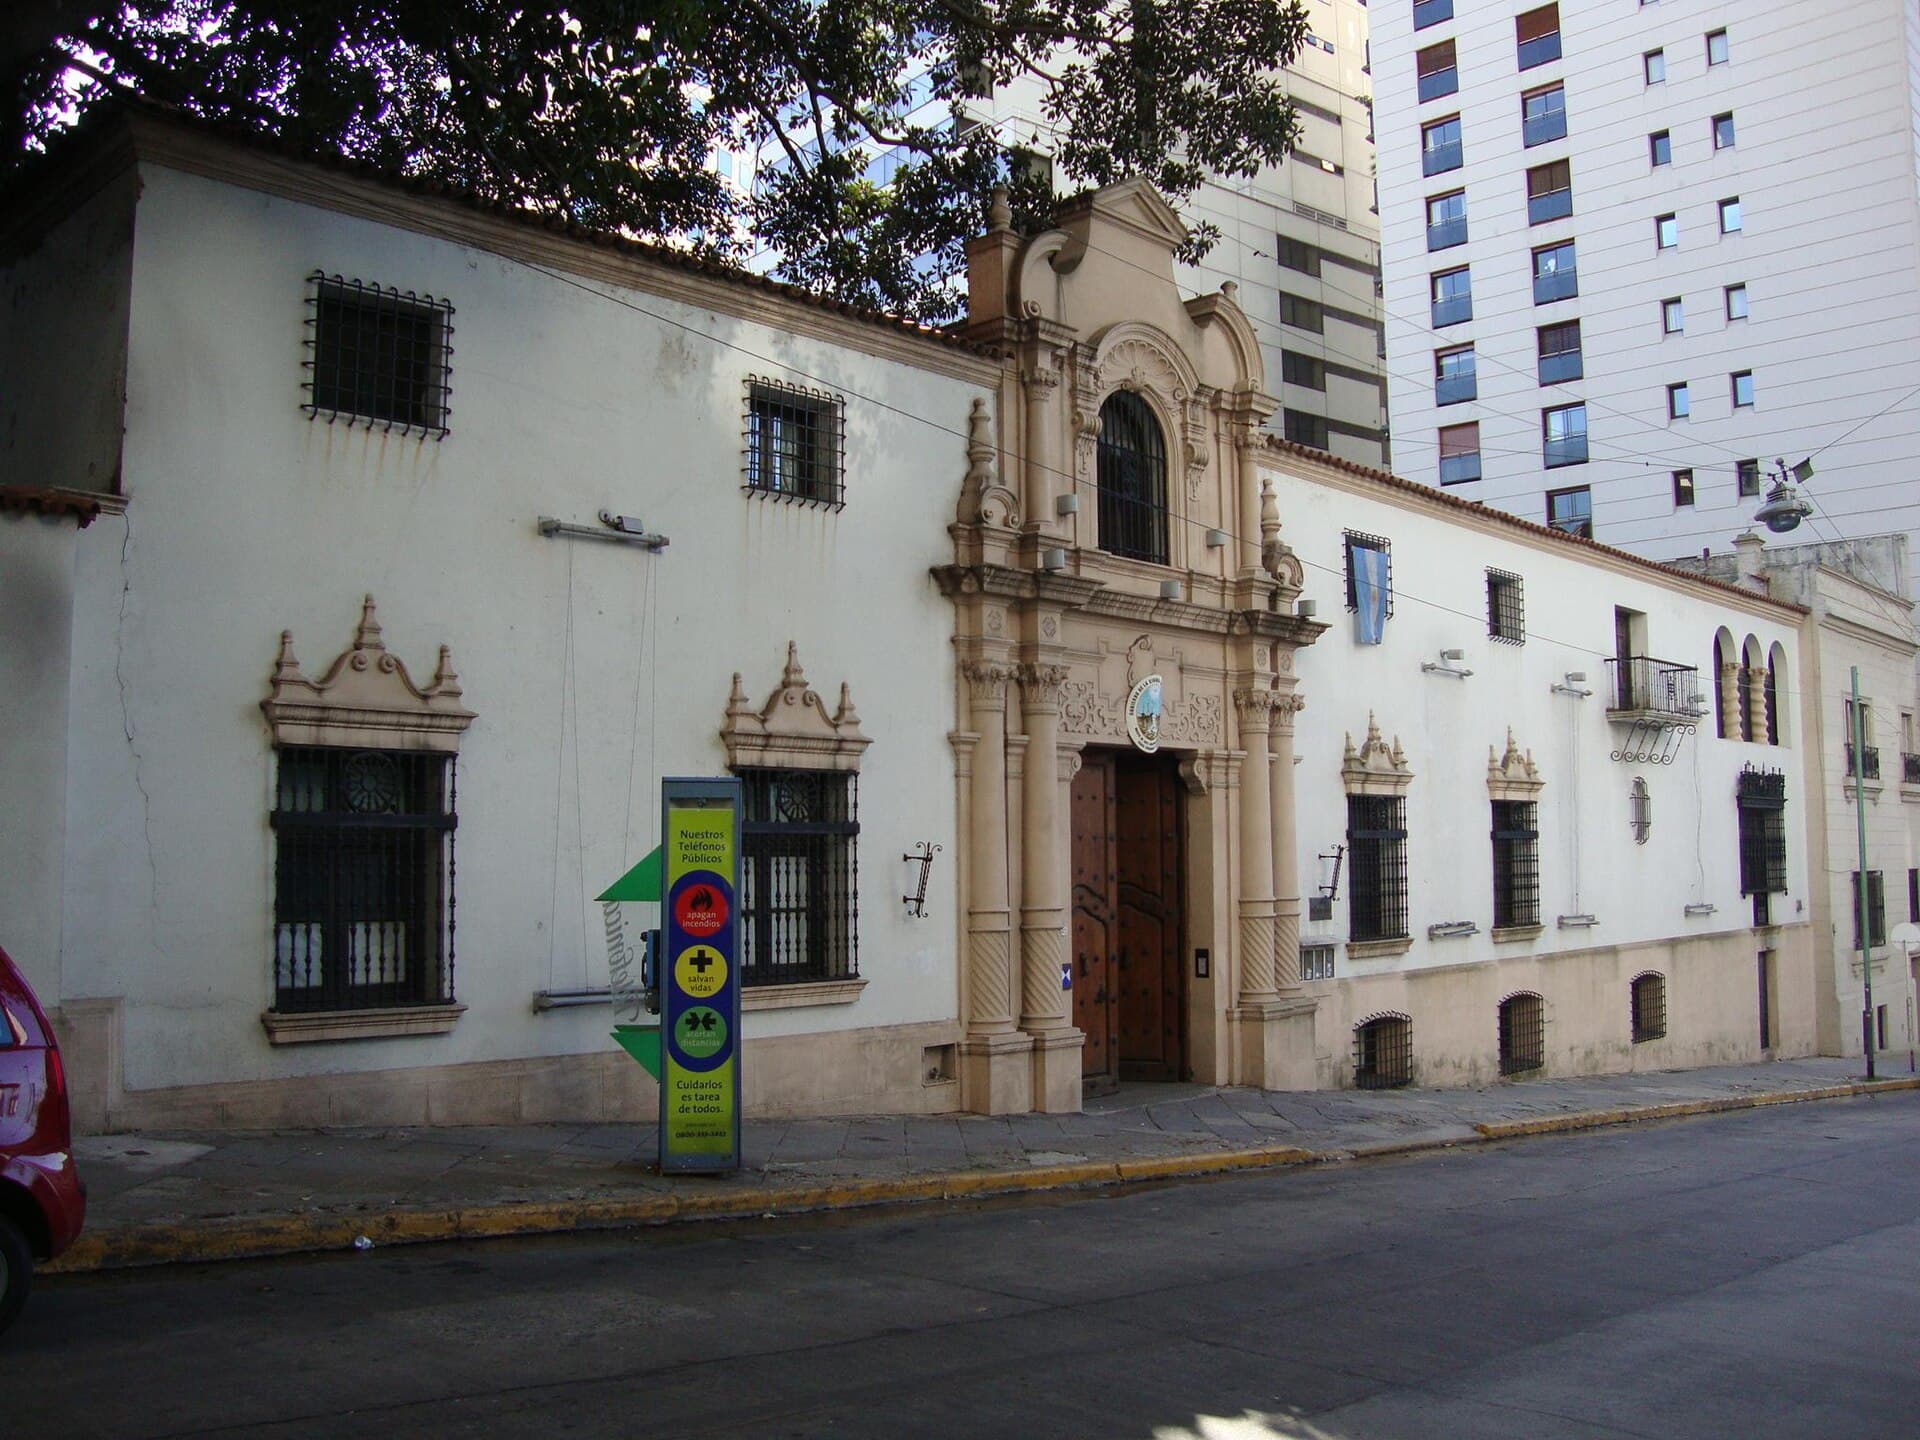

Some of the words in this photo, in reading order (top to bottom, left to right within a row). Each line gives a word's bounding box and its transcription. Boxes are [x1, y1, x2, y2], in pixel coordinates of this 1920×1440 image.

[680, 830, 724, 840] Nuestros
[679, 841, 725, 851] Teléfonos
[682, 853, 722, 863] Públicos
[687, 912, 716, 920] apagan
[682, 920, 720, 928] incendios
[688, 975, 714, 983] salvan
[690, 984, 711, 992] vidas
[677, 1080, 722, 1089] Cuidarlos
[695, 1093, 720, 1101] tarea
[679, 1104, 690, 1113] de
[693, 1104, 723, 1113] todos.
